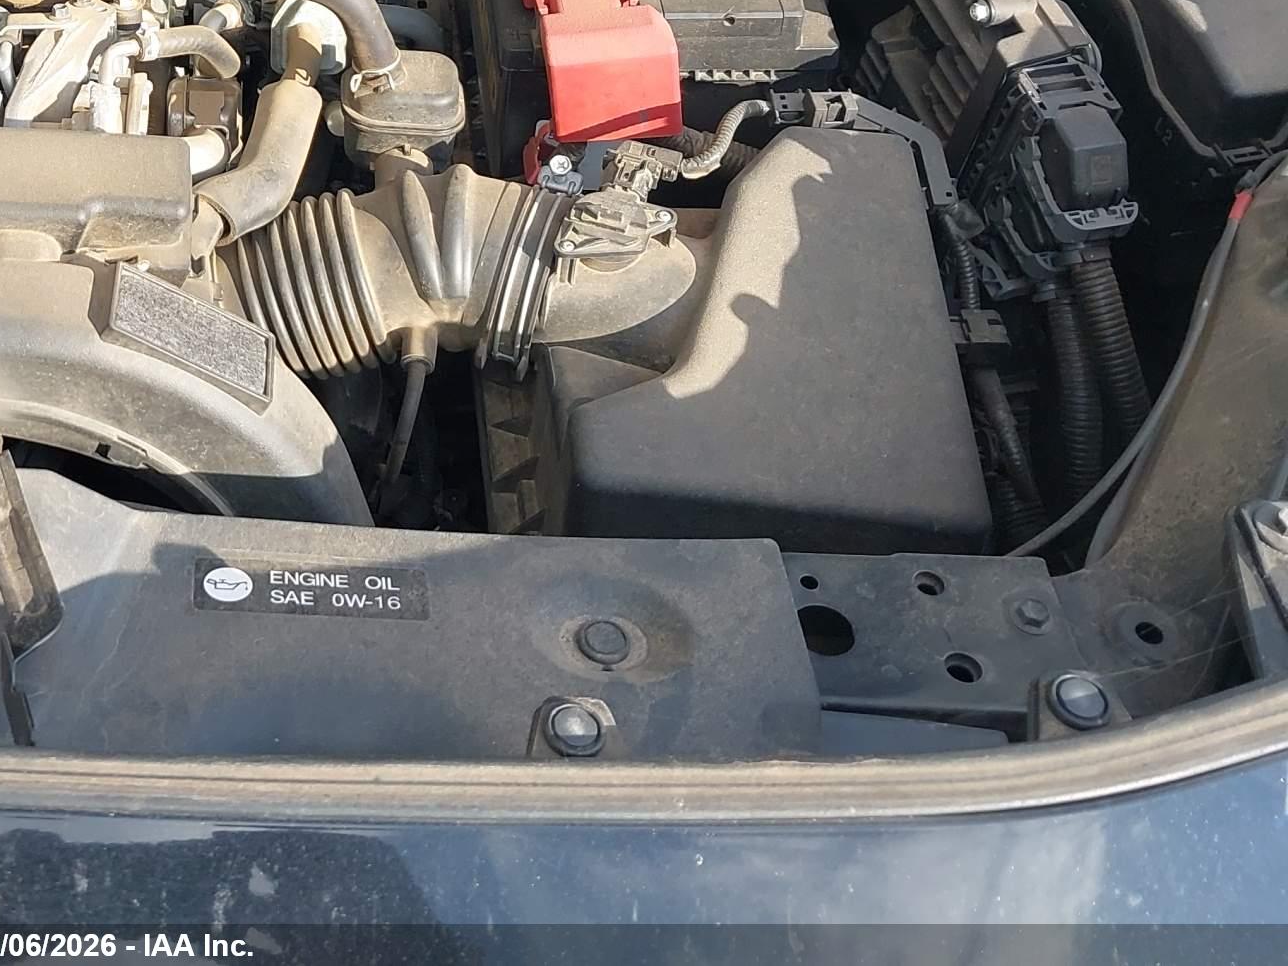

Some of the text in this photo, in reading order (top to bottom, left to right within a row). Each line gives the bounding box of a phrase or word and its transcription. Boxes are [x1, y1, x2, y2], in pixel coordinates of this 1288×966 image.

[269, 570, 401, 591] ENGINE OIL
[270, 589, 401, 610] SAE 0W-16
